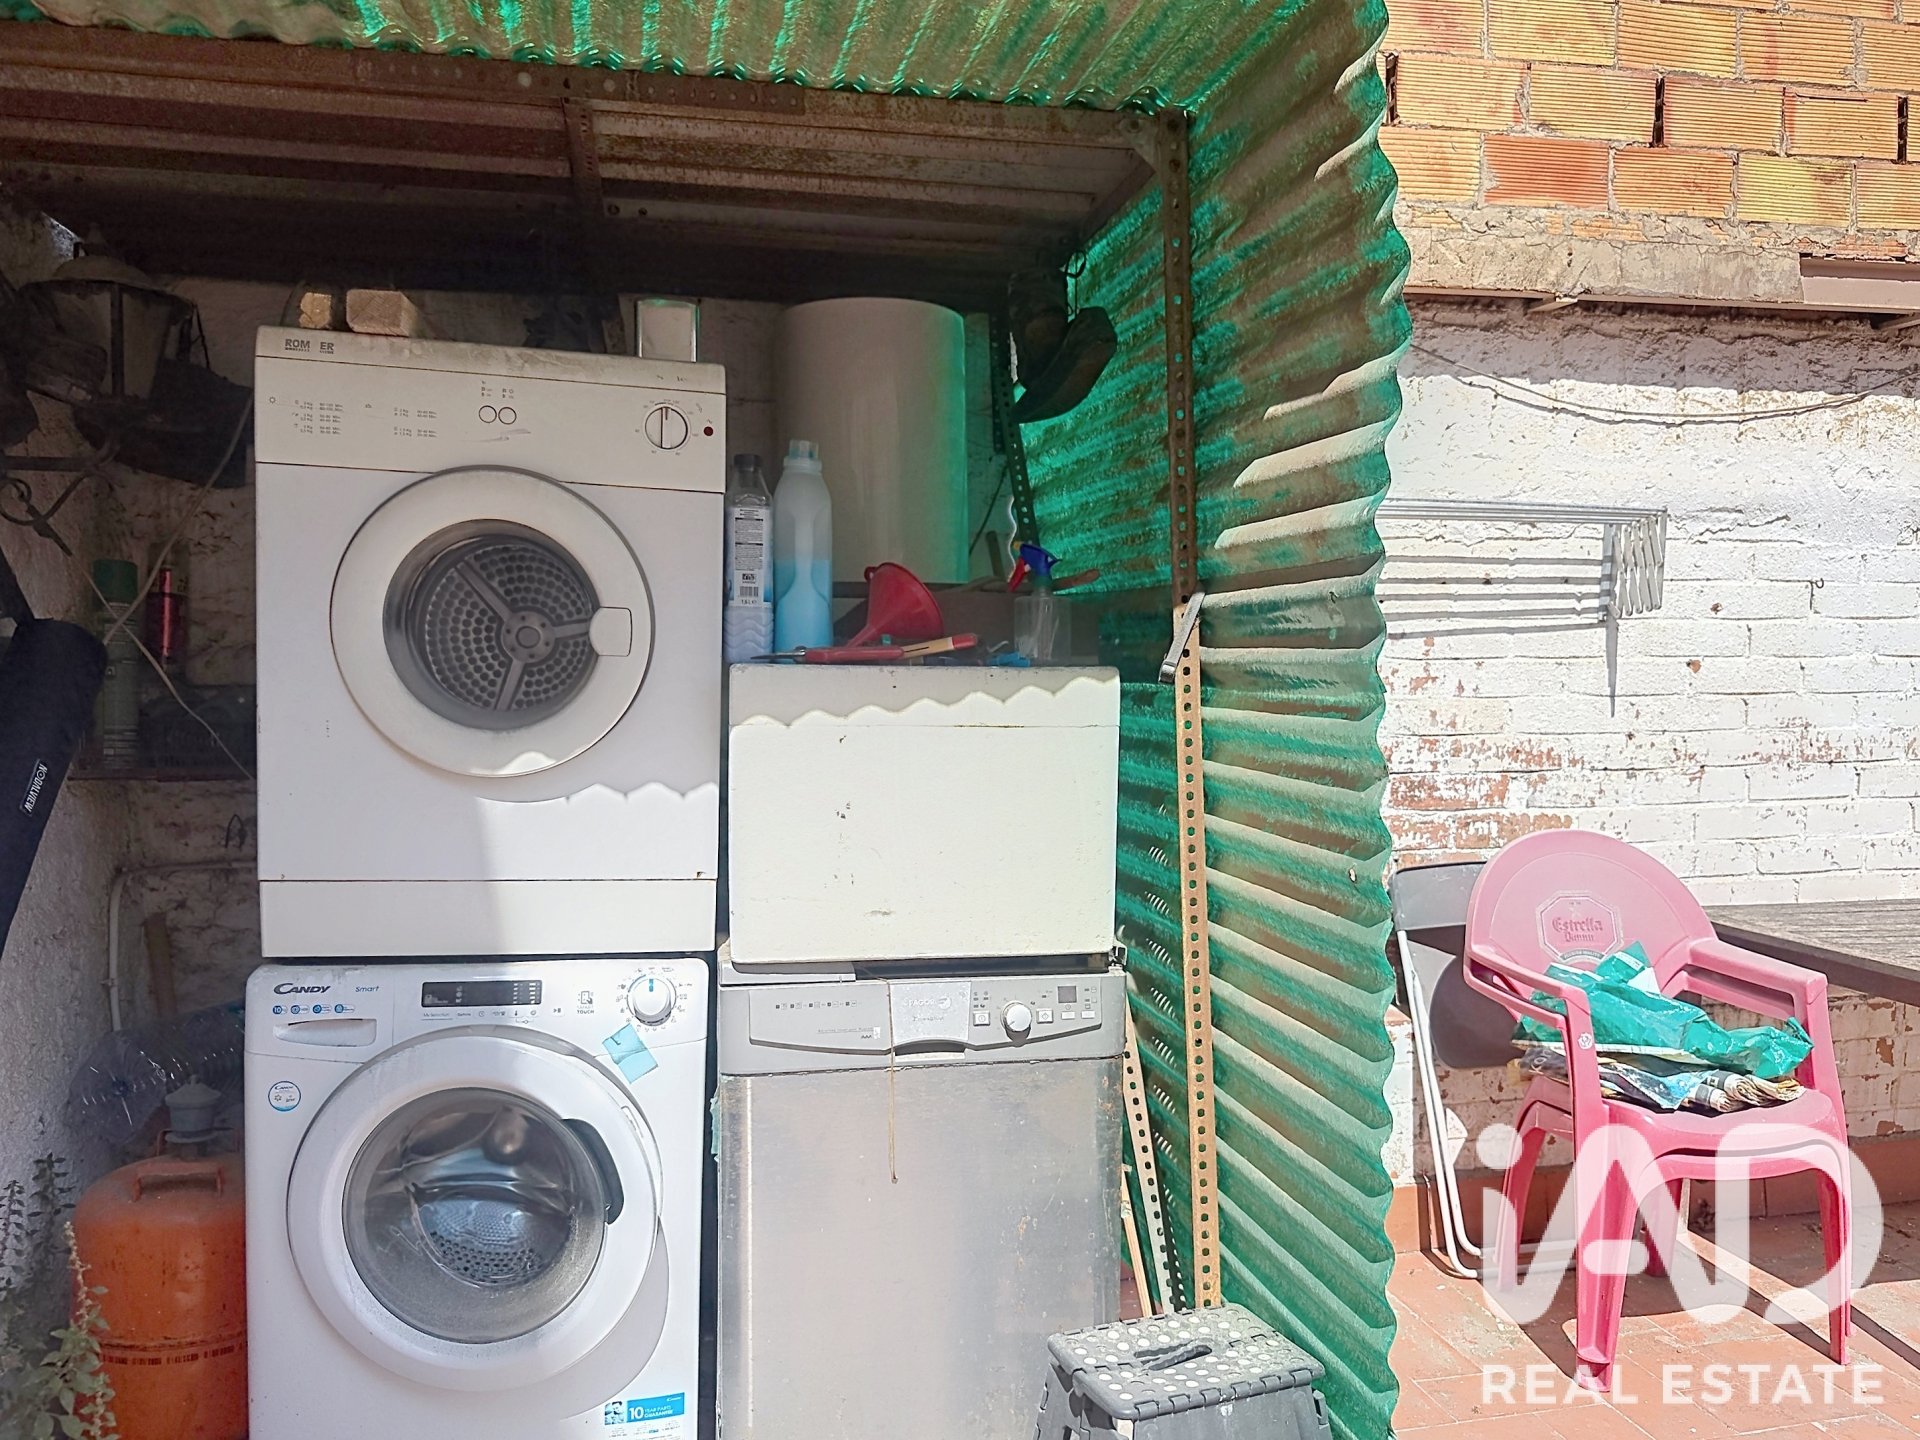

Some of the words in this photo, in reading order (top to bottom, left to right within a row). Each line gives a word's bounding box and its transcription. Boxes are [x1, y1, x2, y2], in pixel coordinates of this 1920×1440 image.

[24, 763, 48, 812] NODALVIEW
[1552, 917, 1603, 932] Estrella
[273, 983, 331, 995] CANDY
[628, 1406, 644, 1420] 10
